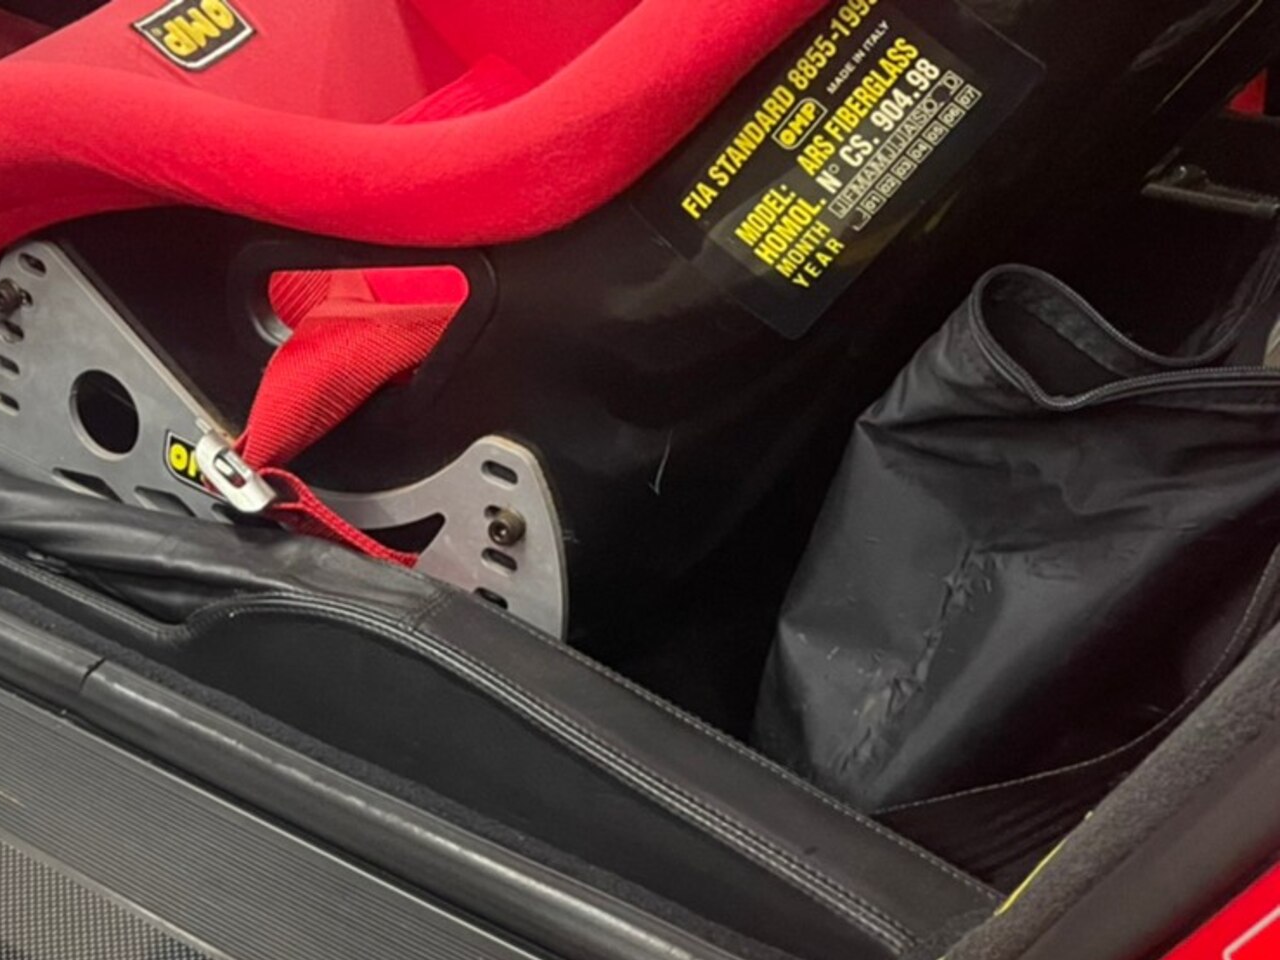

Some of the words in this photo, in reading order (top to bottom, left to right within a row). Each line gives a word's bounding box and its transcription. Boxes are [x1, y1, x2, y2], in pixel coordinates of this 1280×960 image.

[163, 0, 234, 56] OMP
[827, 62, 855, 95] MADE
[853, 50, 866, 63] IN
[863, 20, 889, 52] ITALY
[681, 182, 718, 219] FIA
[707, 85, 795, 188] STANDARD
[788, 0, 879, 90] 8855-199
[734, 184, 796, 247] MODEL:
[796, 135, 836, 176] ARS
[824, 37, 919, 142] FIBERGLASS
[780, 102, 817, 146] OMP
[754, 198, 826, 264] HOMOL.
[839, 134, 880, 167] CS.
[870, 58, 940, 132] 904.98
[775, 220, 830, 278] MONTH
[792, 238, 845, 288] YEAR
